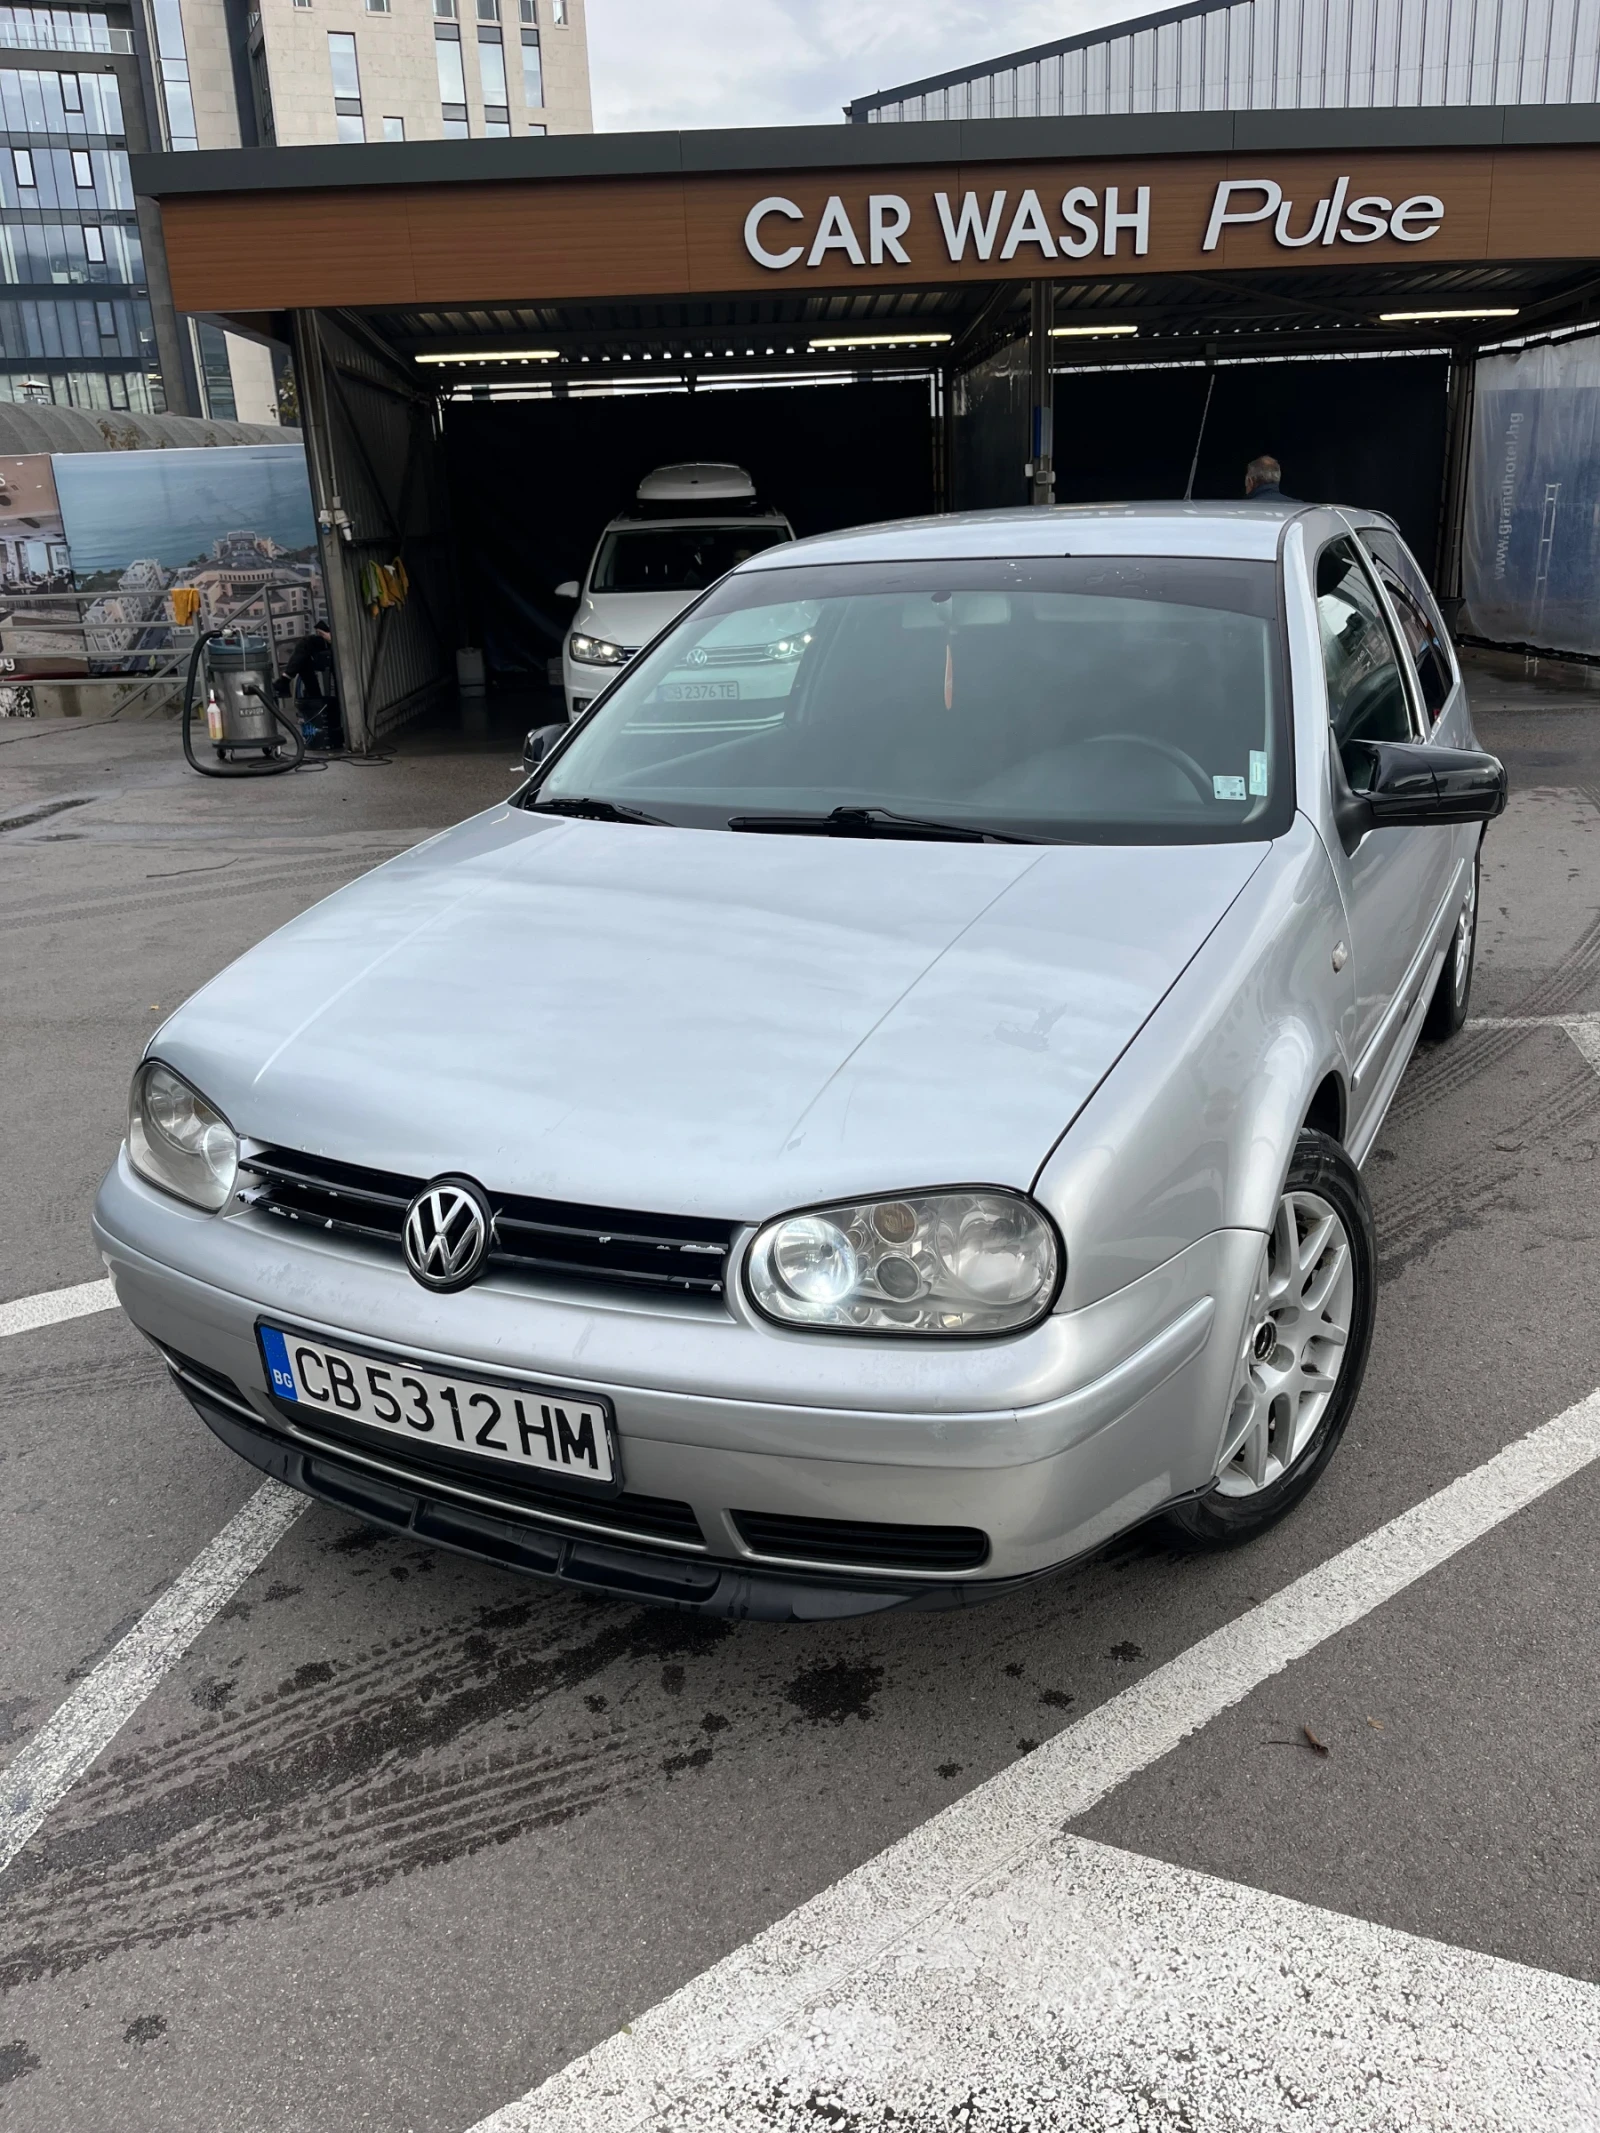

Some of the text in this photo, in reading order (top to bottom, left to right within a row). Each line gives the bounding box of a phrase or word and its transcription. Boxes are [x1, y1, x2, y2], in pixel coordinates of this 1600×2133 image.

[743, 176, 1445, 269] CAR WASH Pulse
[1494, 412, 1524, 581] www.grandhotel.bg
[405, 1187, 485, 1283] VW
[273, 1369, 292, 1389] BG
